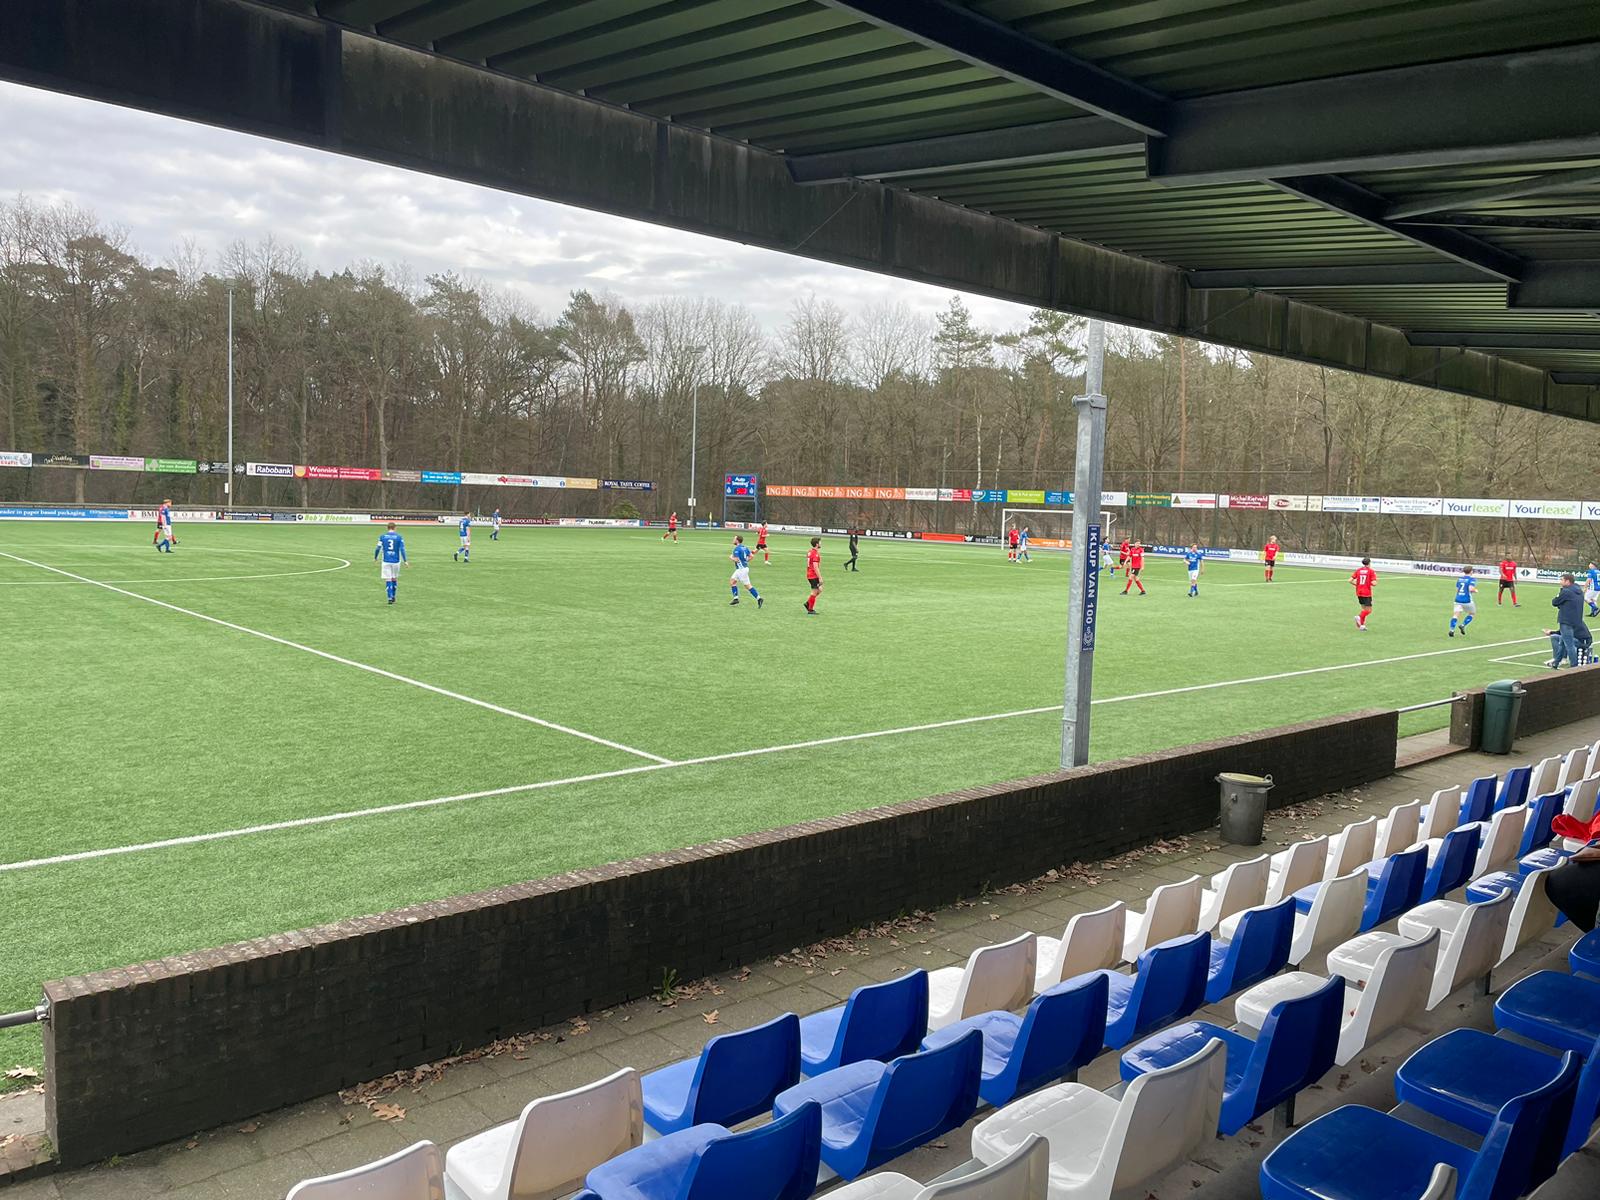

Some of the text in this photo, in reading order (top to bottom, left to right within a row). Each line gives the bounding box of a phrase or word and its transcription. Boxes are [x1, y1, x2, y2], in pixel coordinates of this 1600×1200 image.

[256, 466, 292, 475] Rabobank
[767, 486, 781, 496] ING
[792, 487, 807, 496] ING
[819, 487, 834, 497] ING
[847, 488, 863, 498] ING
[875, 489, 892, 498] ING
[1447, 502, 1501, 514] Yourlease
[1514, 504, 1574, 515] Yourlease
[388, 539, 394, 551] 3
[1086, 532, 1098, 624] KLUP VAN 100
[1459, 583, 1465, 592] 2
